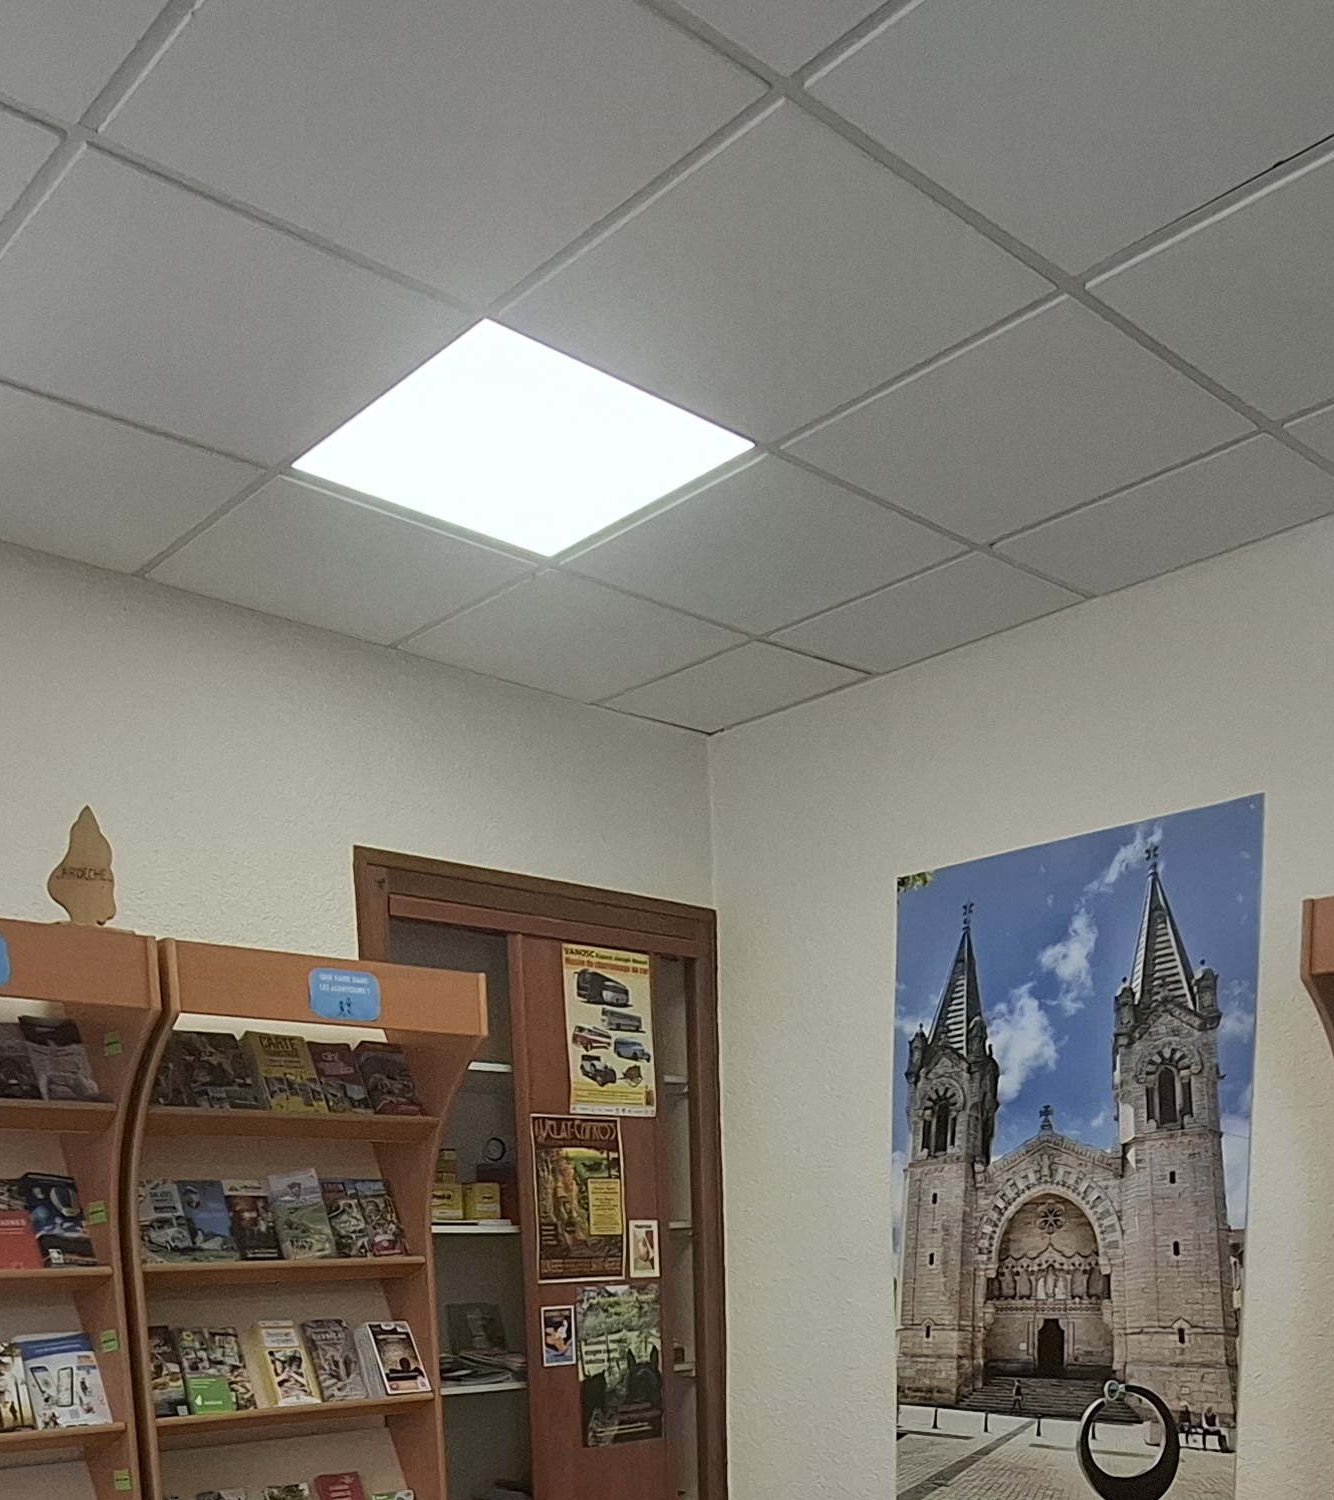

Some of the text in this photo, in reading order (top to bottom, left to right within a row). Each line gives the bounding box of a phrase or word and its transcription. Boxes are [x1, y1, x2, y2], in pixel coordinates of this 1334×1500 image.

[319, 973, 333, 982] QUE
[334, 974, 351, 984] FAIRE
[319, 983, 329, 991] LES
